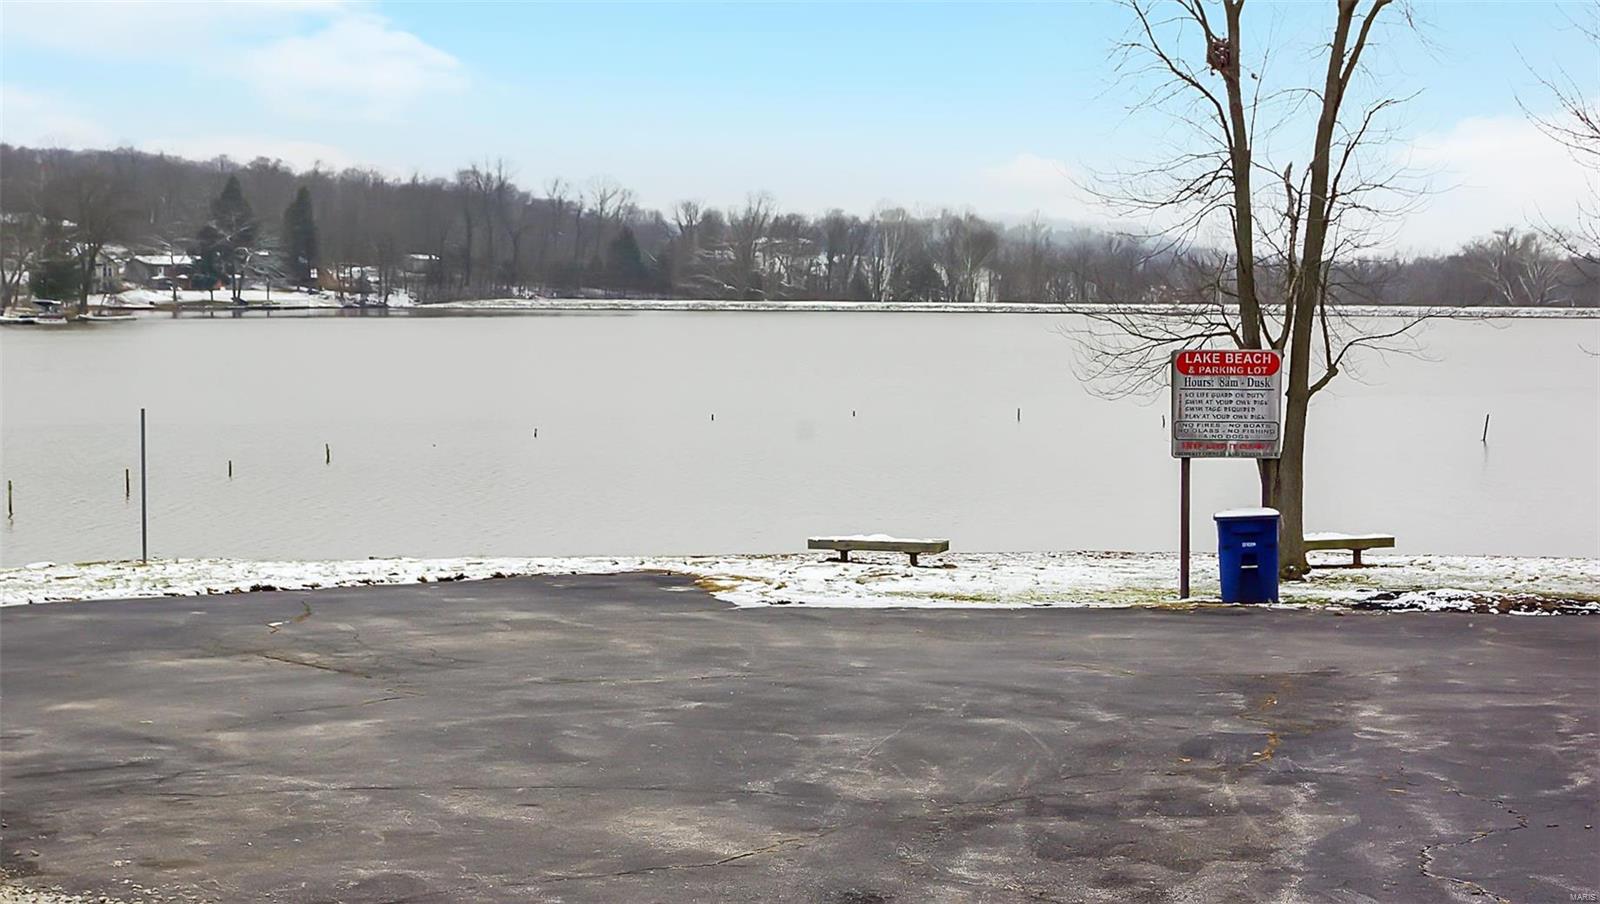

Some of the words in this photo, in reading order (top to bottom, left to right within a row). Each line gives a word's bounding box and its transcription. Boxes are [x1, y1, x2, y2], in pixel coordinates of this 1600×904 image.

[1185, 353, 1220, 364] LAKE
[1225, 353, 1271, 364] BEACH
[1188, 366, 1195, 374] &
[1199, 366, 1244, 374] PARKING
[1248, 366, 1267, 374] LOT
[1184, 377, 1214, 387] Hours:
[1219, 377, 1239, 387] 8am
[1247, 377, 1271, 387] Dusk
